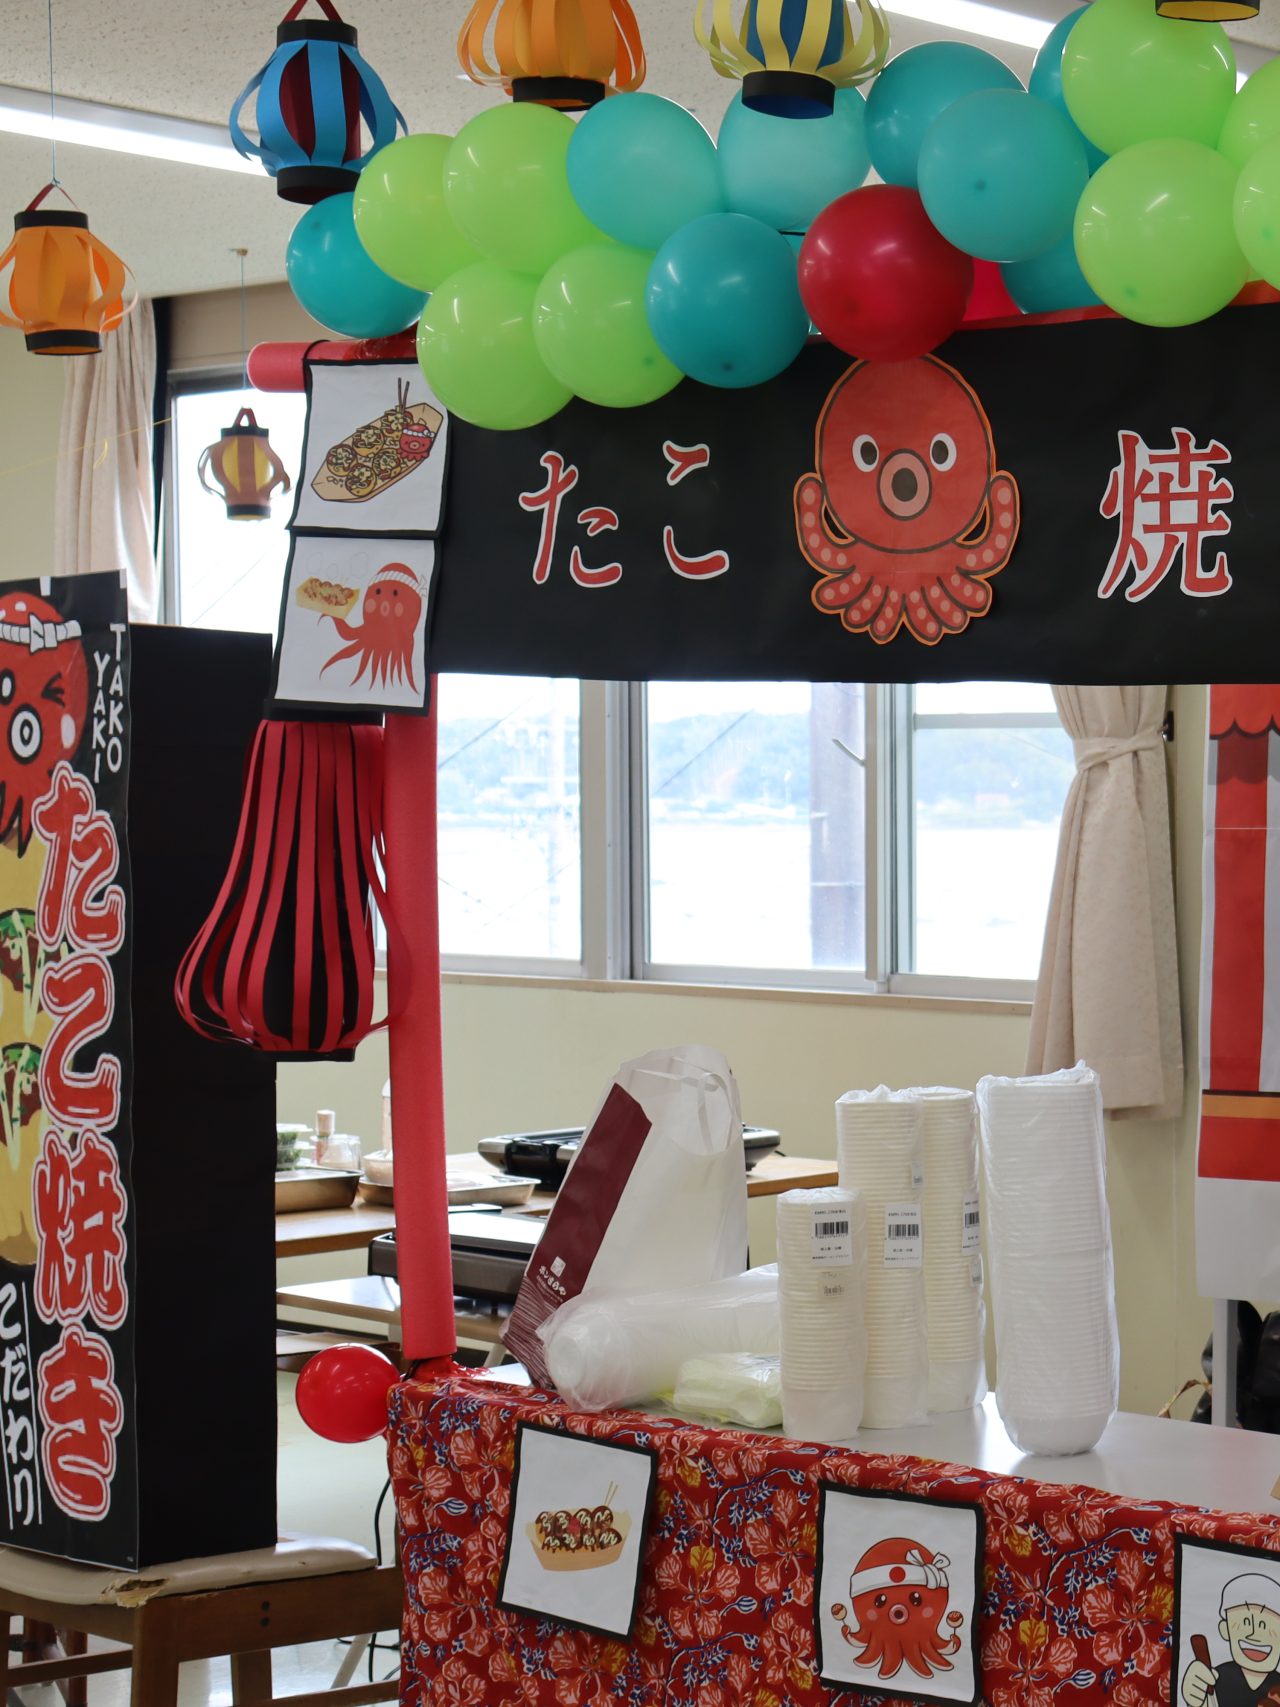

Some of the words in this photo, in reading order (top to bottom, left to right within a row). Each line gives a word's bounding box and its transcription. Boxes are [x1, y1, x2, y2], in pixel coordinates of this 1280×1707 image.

[92, 651, 110, 783] YAKI
[107, 623, 126, 773] TAKO
[32, 760, 129, 1521] たこ焼き
